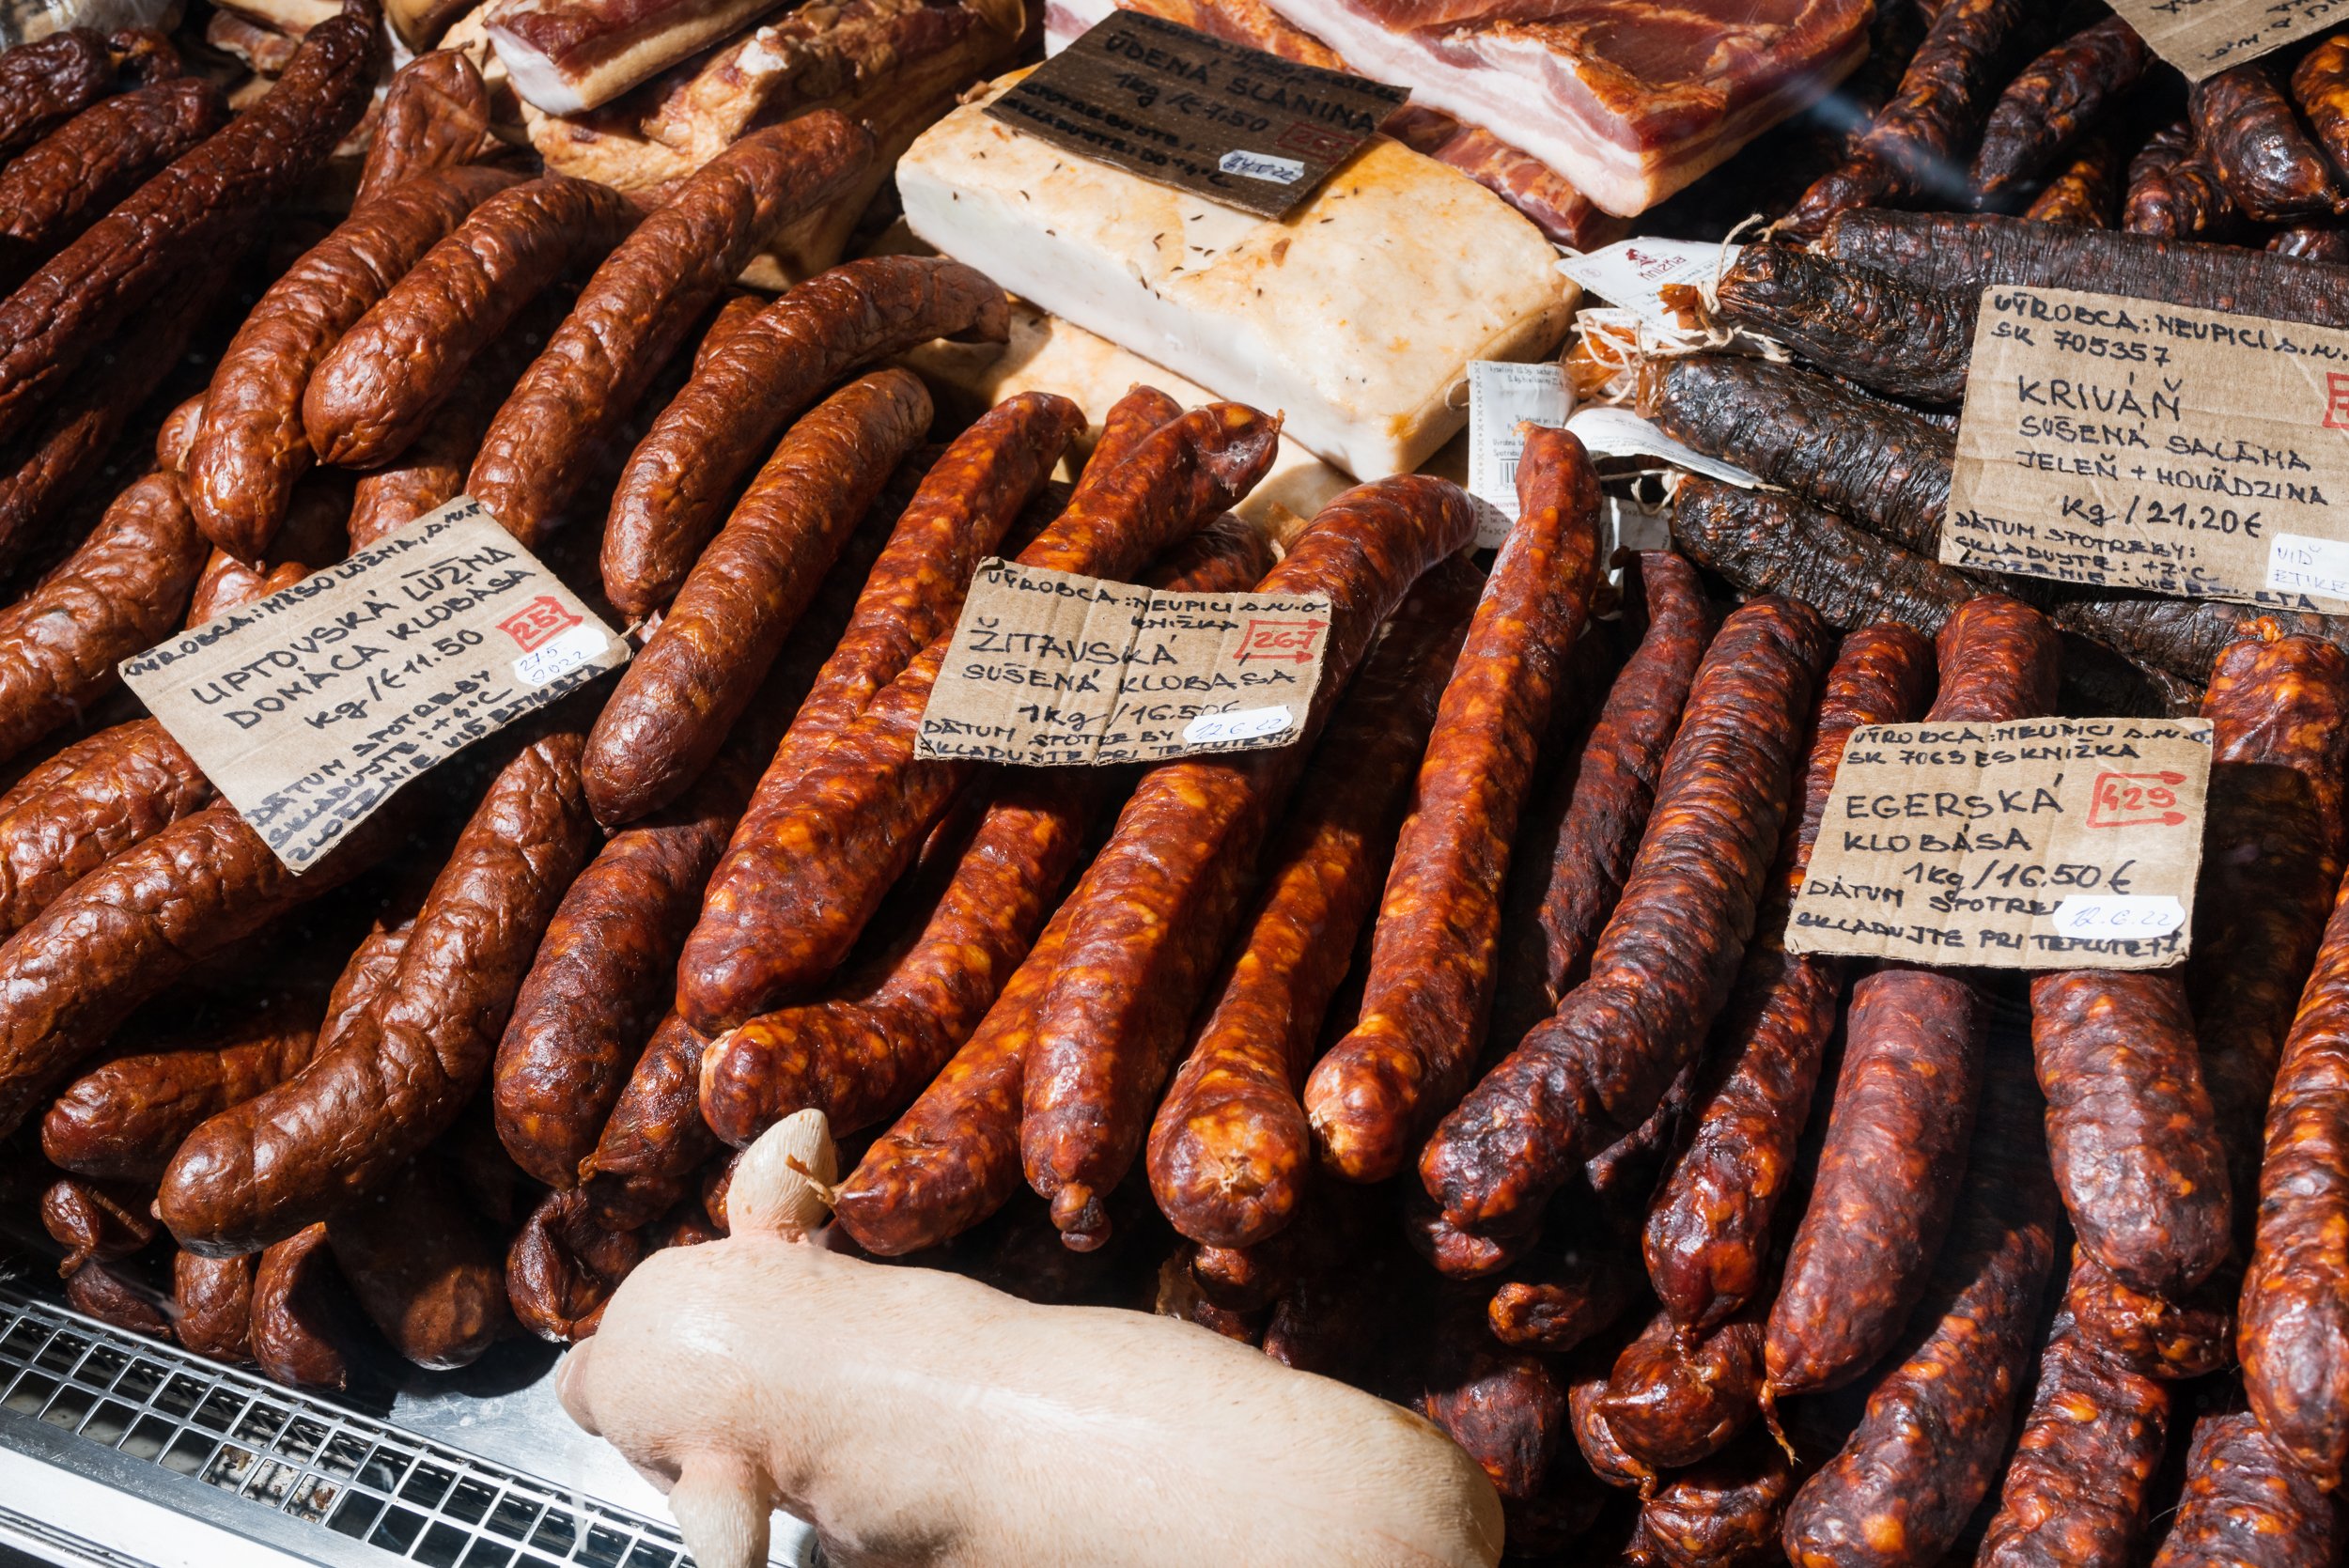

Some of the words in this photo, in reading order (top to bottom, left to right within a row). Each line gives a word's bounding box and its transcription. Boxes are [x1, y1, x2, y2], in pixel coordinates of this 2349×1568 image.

[1225, 75, 1377, 134] SLANINA
[1990, 320, 2036, 347] SK
[2053, 329, 2172, 367] 705357
[2155, 315, 2268, 349] NEUPICI
[2017, 372, 2185, 422] KRIVÁŇ
[2019, 414, 2151, 450] SUŠENÁ
[2015, 450, 2119, 482] JELEŇ
[2156, 466, 2329, 506] HOVÄDZINA
[224, 643, 390, 731] DOMÁCA
[387, 566, 537, 642] KLOBÁSA
[968, 616, 1179, 666] ŽITAVSKÁ
[1252, 630, 1318, 650] 267
[960, 661, 1102, 693] SUŠENÁ
[1846, 751, 1888, 765] SK
[1844, 772, 2065, 821] EGERSKÁ
[2100, 784, 2178, 812] 429
[1843, 822, 2033, 854] KLOBÁSA
[1805, 875, 1905, 908] DÁTUM
[1979, 929, 2023, 951] PRI
